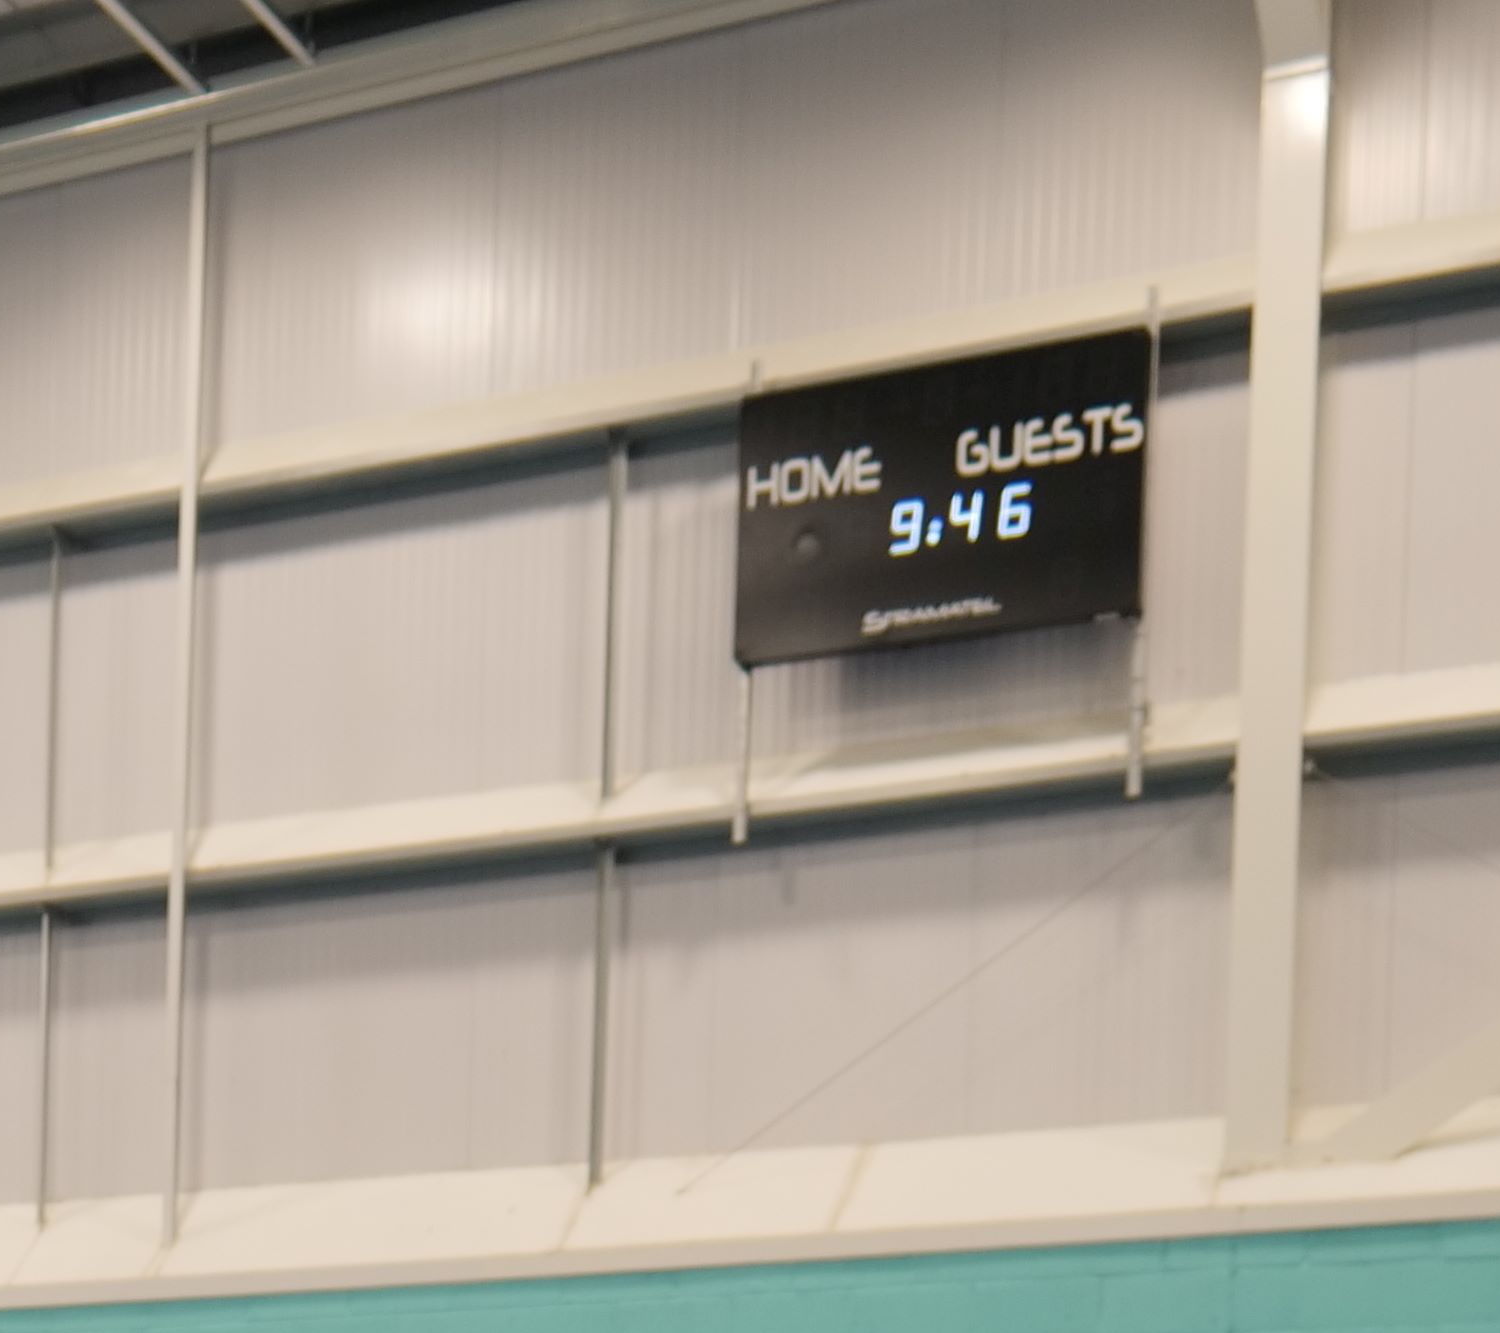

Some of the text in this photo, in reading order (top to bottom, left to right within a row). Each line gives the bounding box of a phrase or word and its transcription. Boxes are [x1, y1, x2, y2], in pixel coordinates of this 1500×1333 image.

[746, 403, 1144, 509] HOME GUESTS
[888, 480, 1034, 556] 9:46
